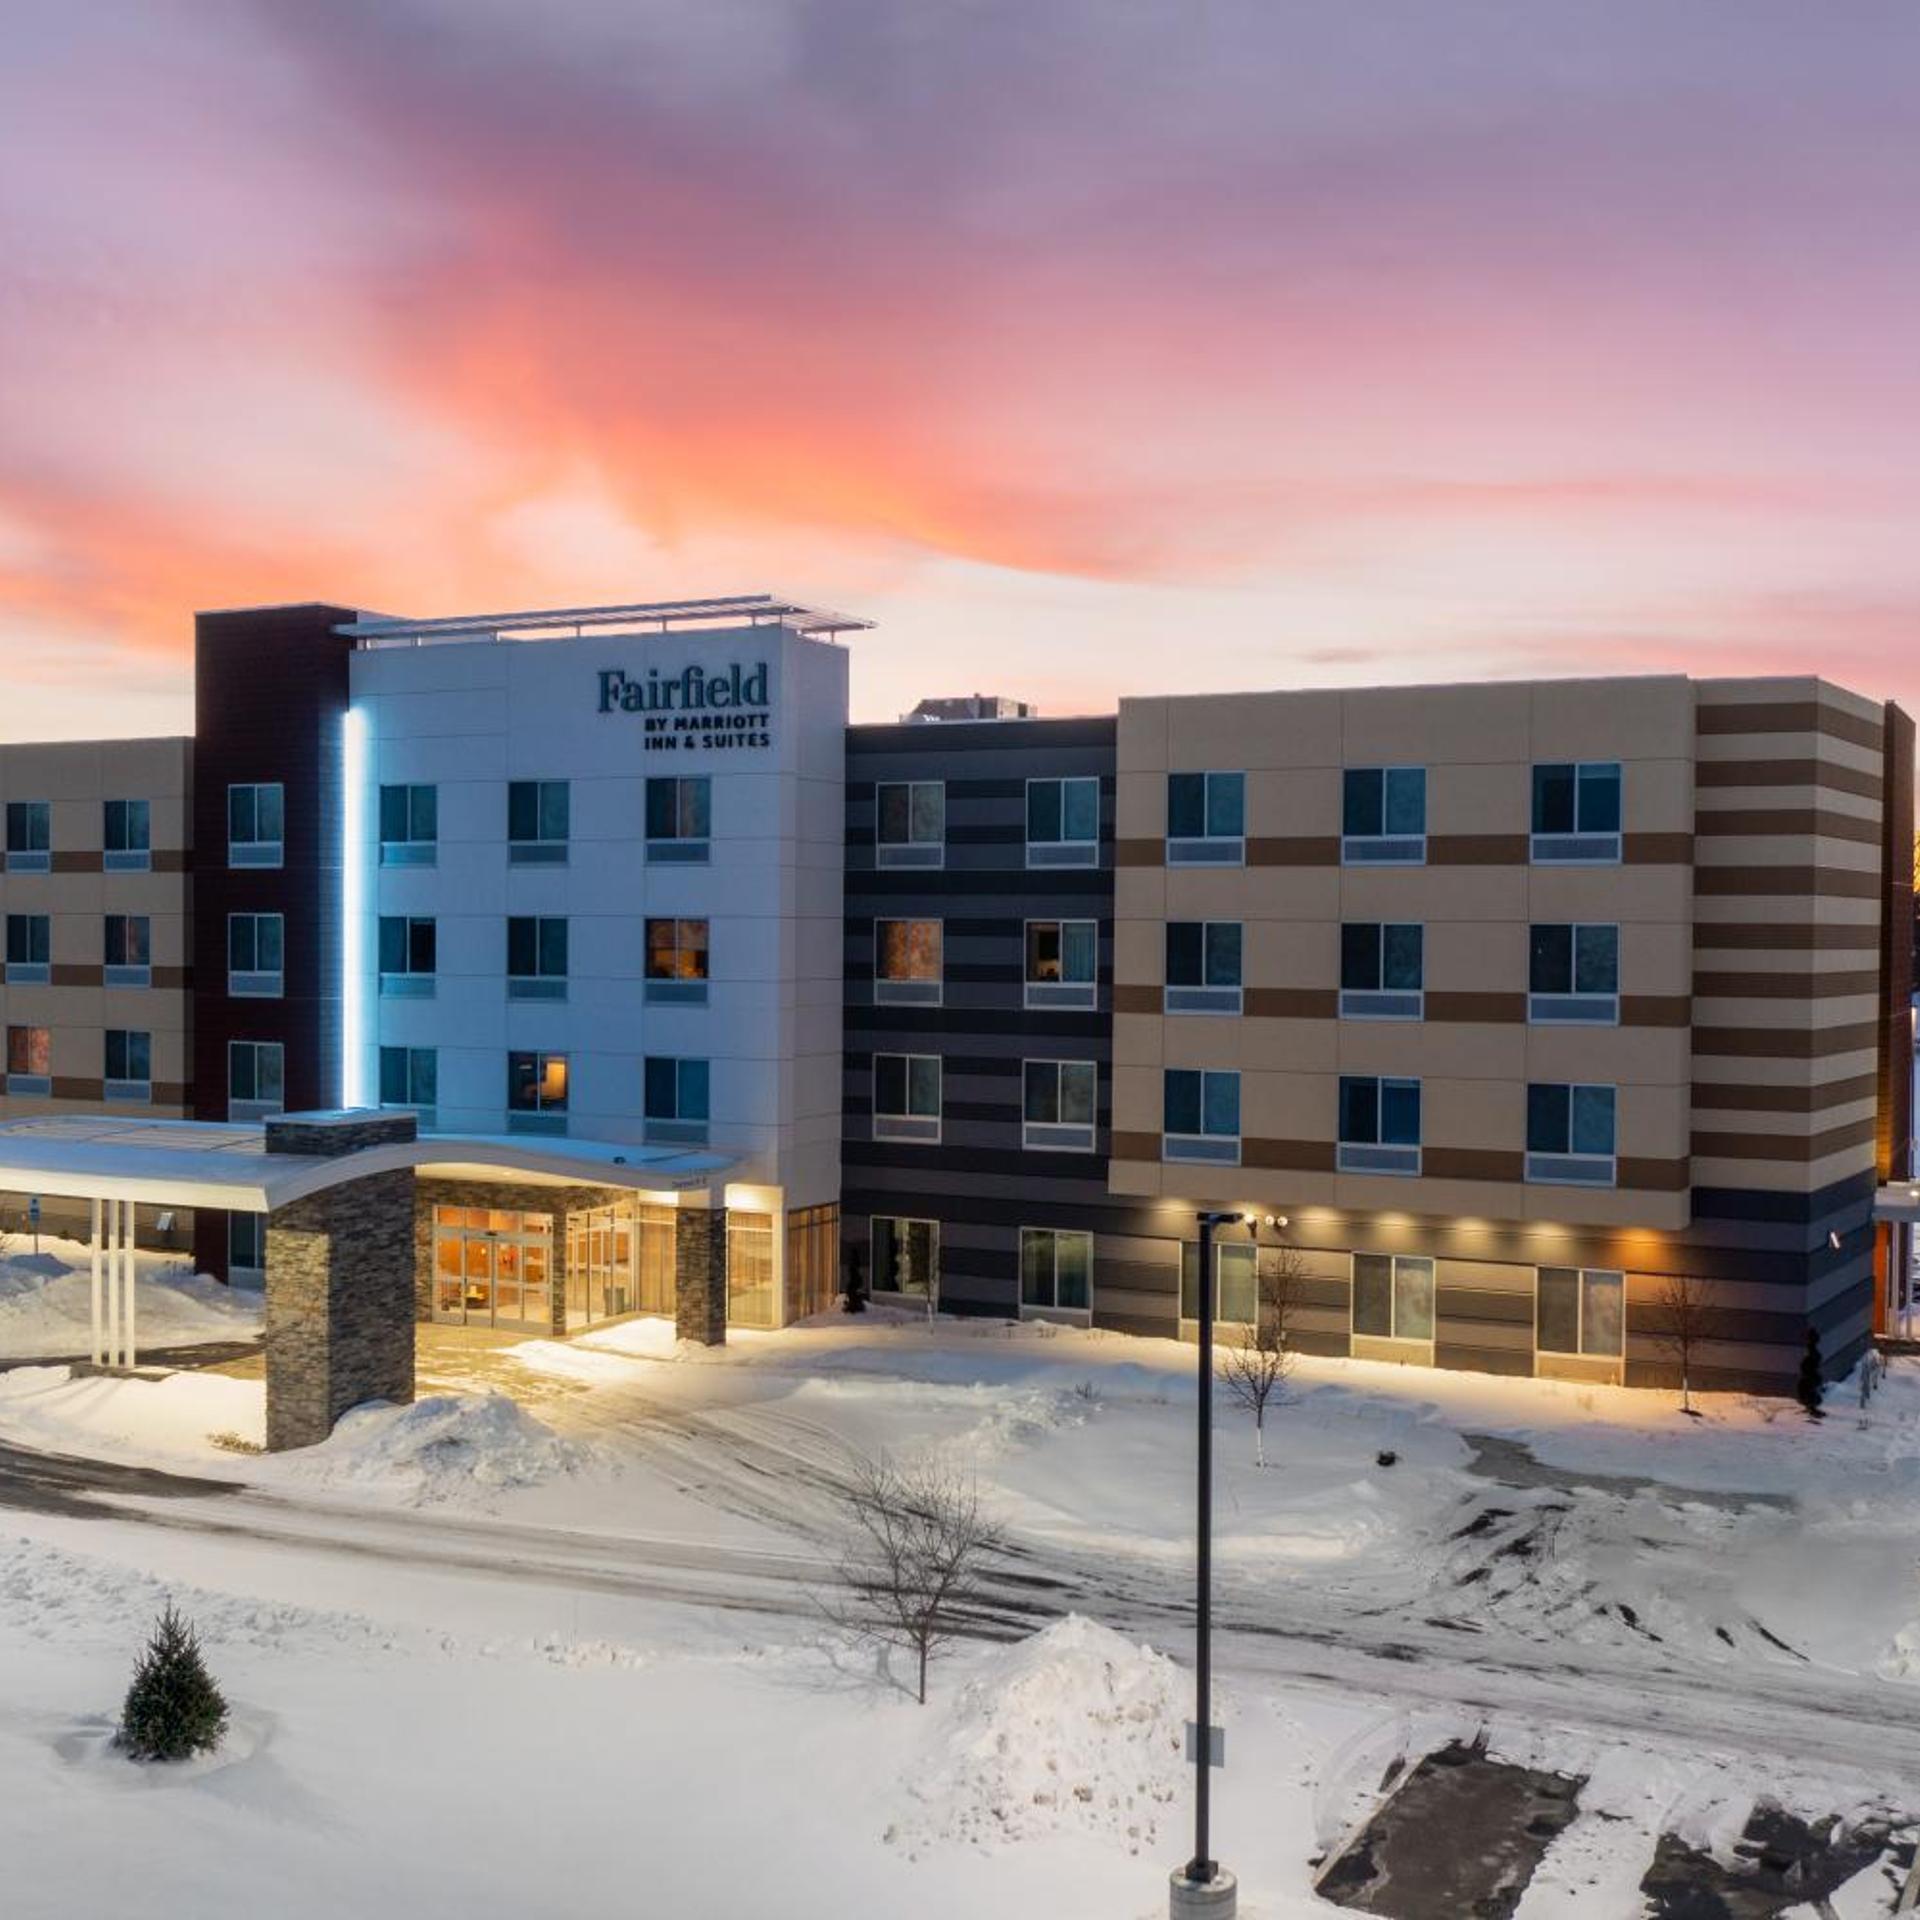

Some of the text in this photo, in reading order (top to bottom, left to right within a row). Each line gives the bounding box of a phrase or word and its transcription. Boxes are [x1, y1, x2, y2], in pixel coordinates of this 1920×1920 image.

[597, 662, 770, 714] Fairfield
[644, 713, 770, 732] BY MARRIOTT
[644, 733, 770, 750] INN & SUITES
